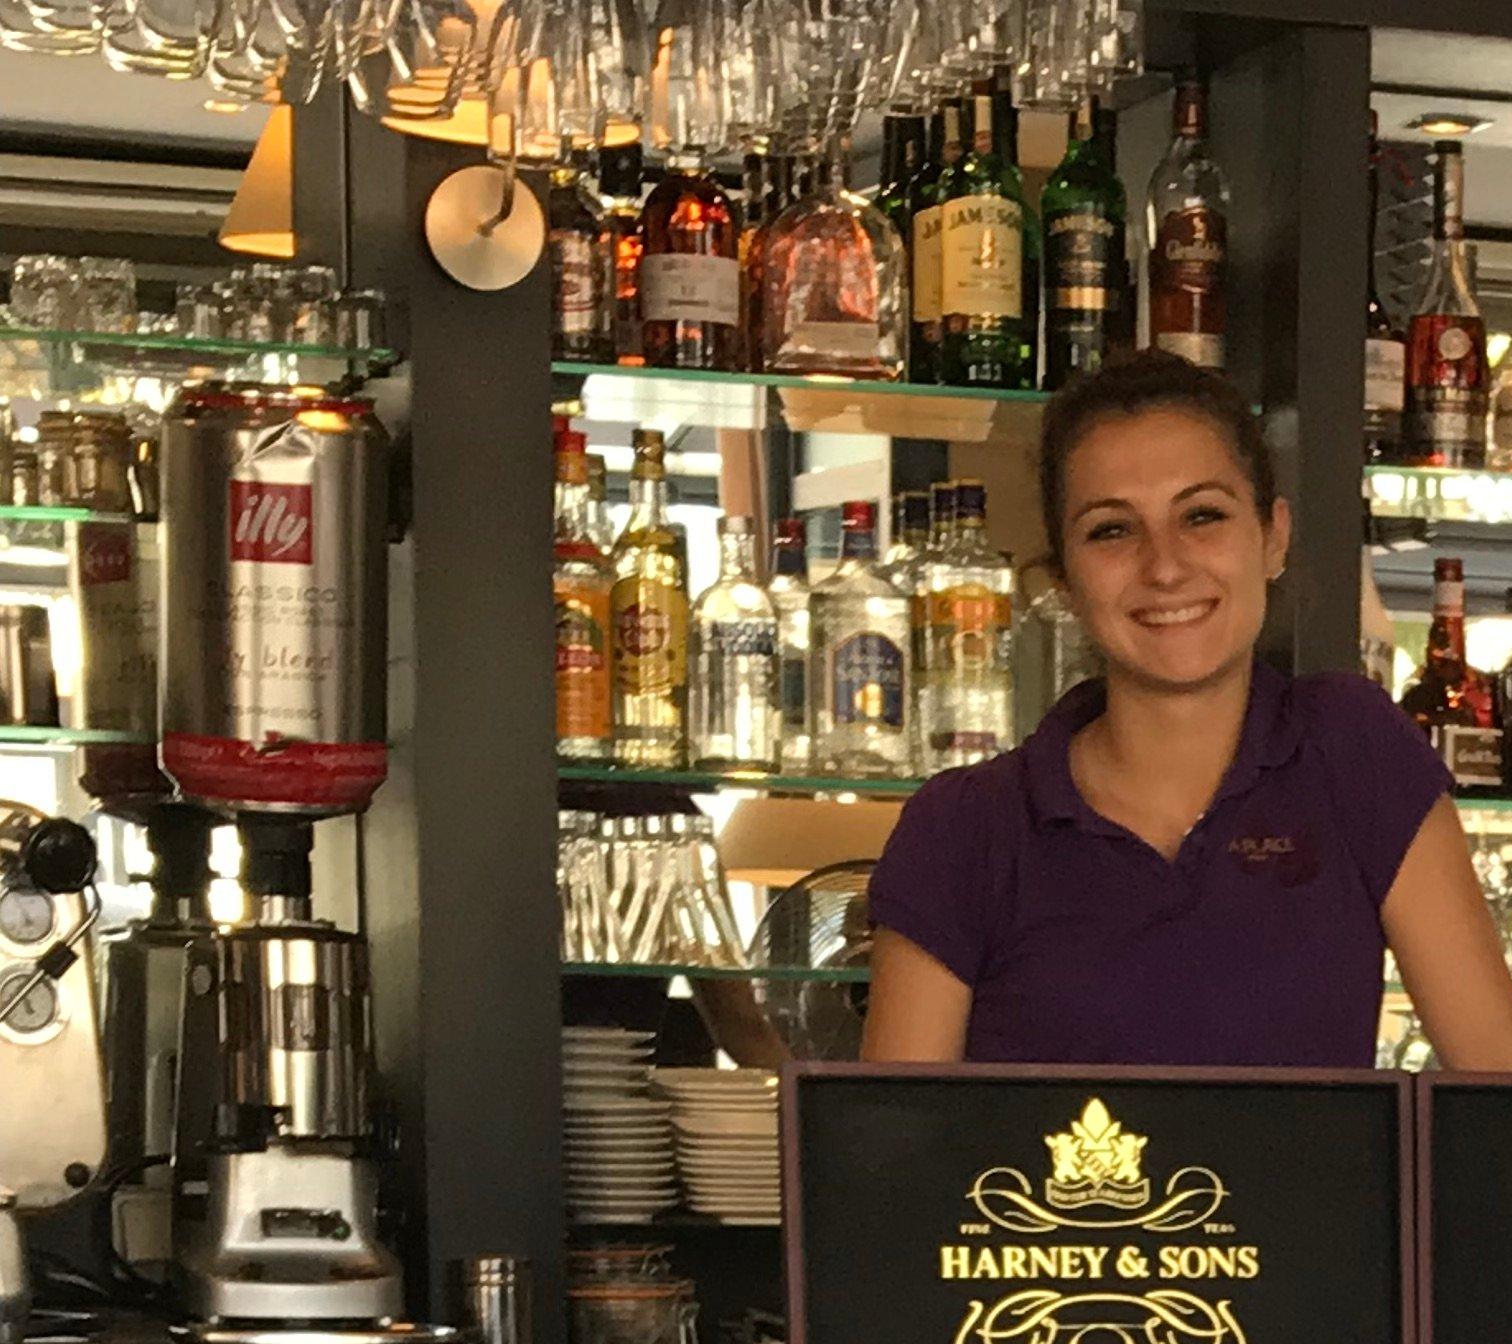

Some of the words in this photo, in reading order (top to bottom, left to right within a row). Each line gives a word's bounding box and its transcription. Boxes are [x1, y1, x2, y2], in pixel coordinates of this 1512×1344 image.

[235, 494, 308, 556] illy
[941, 1246, 1109, 1279] HARNEY
[1116, 1246, 1150, 1278] &
[1159, 1246, 1259, 1279] SONS
